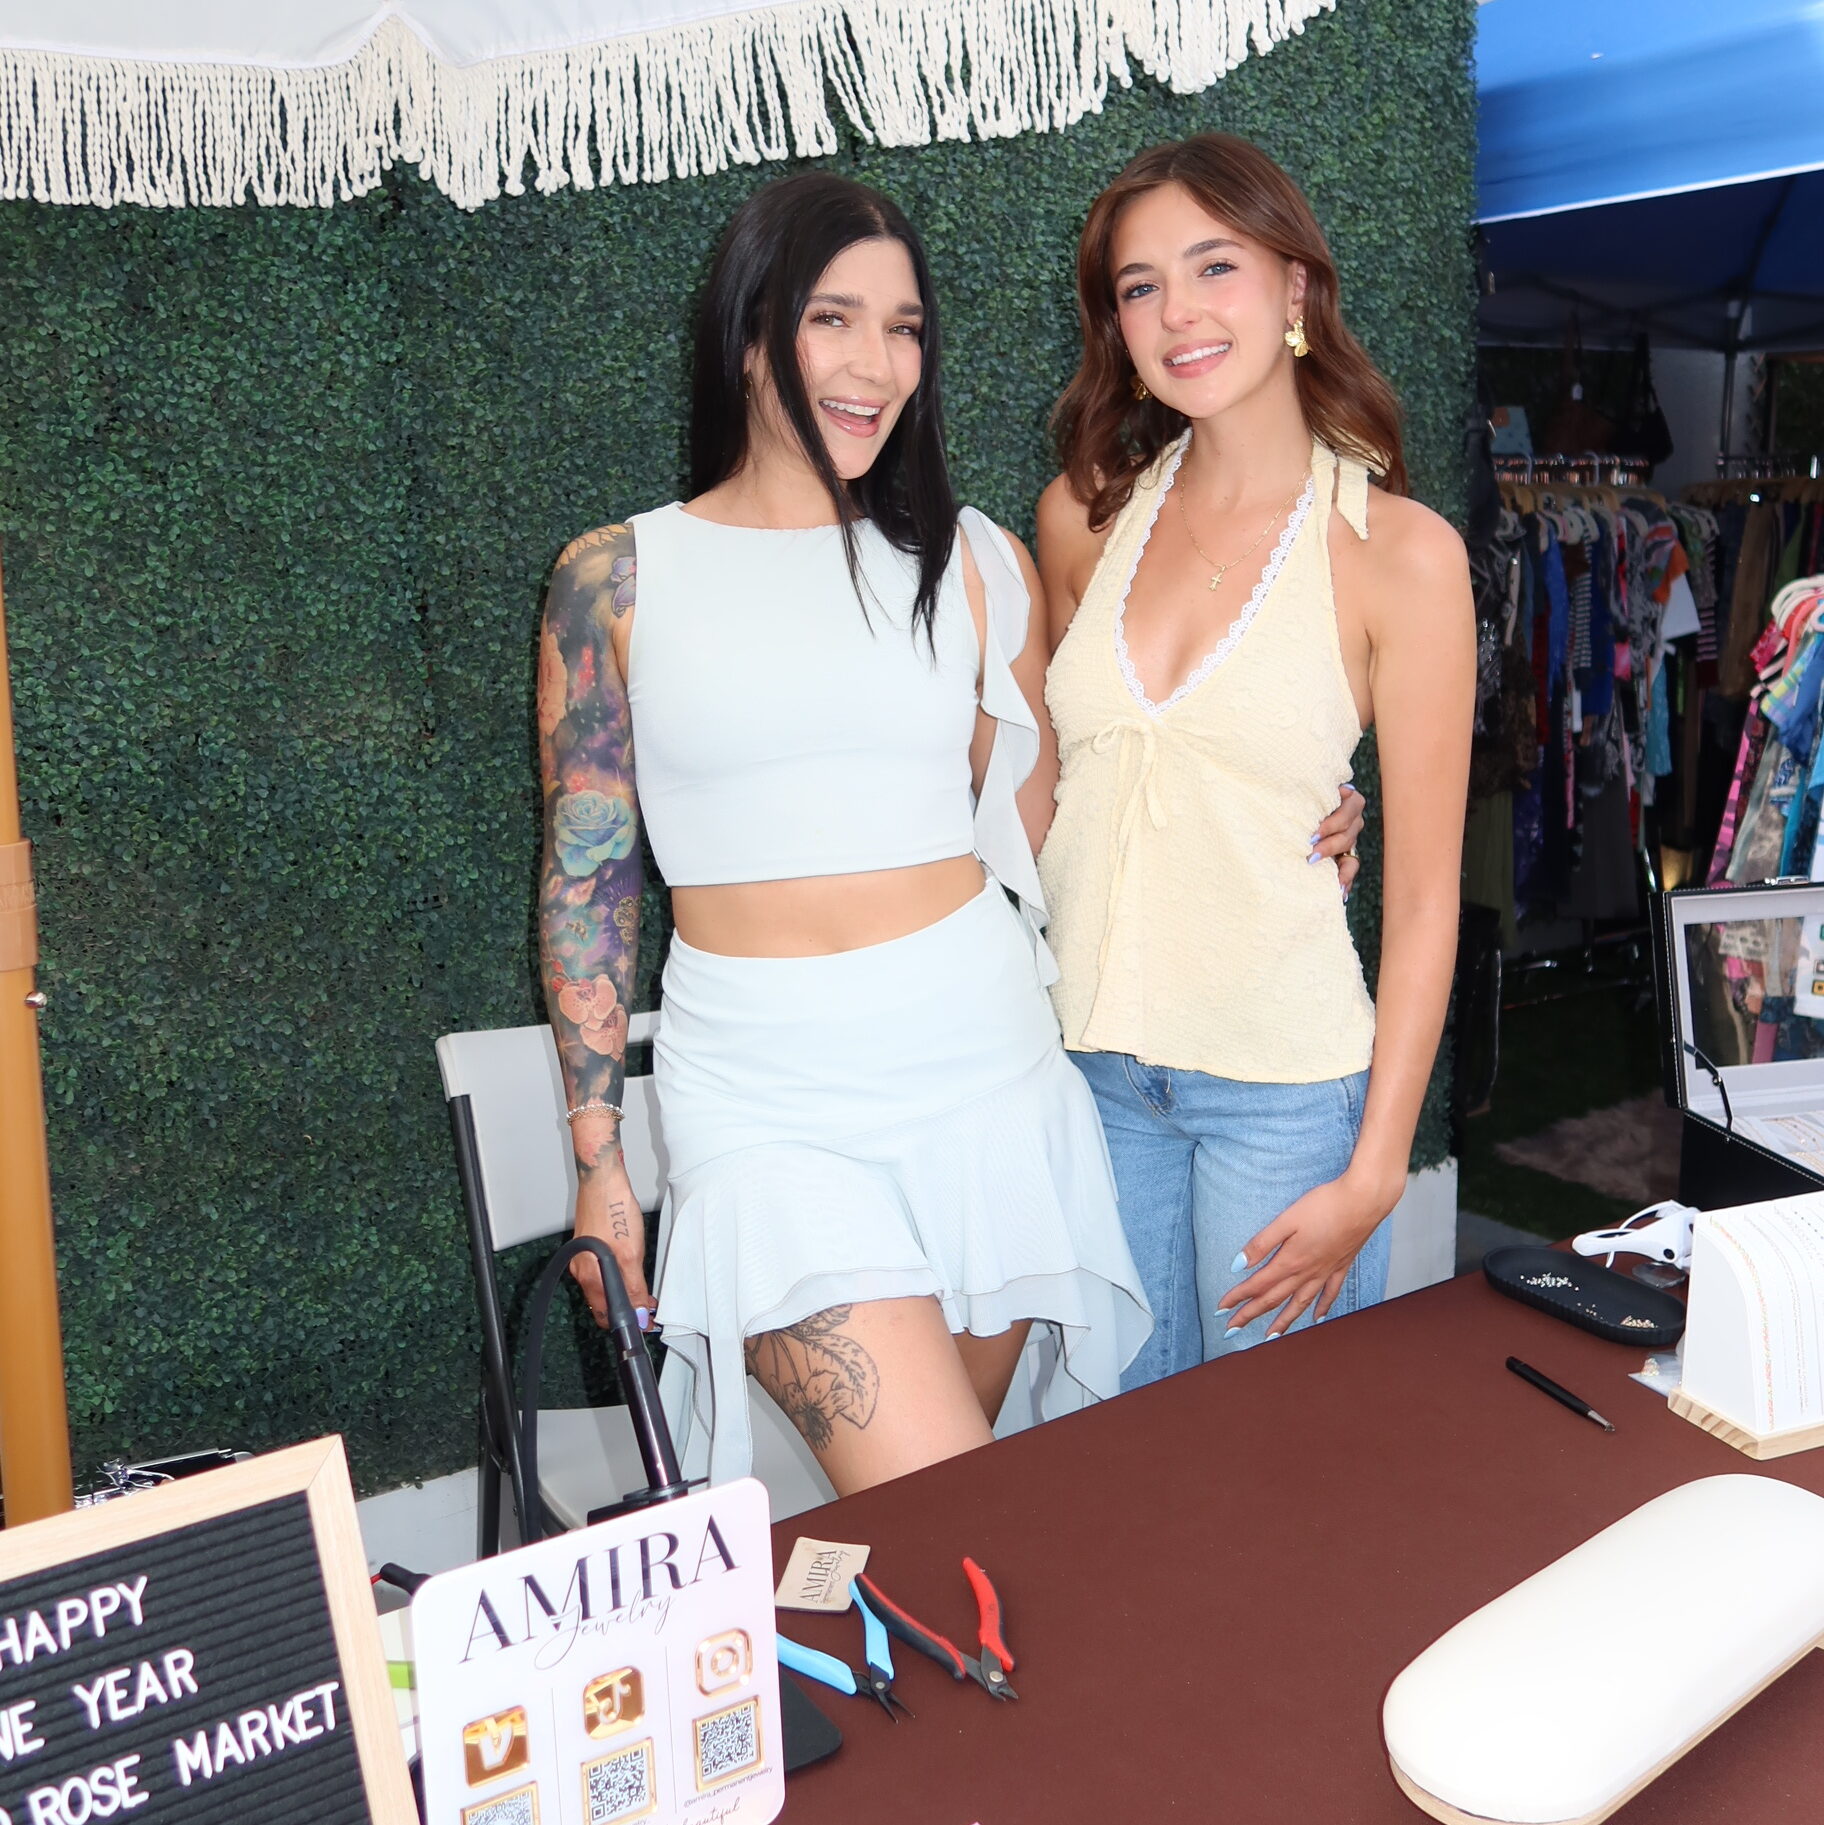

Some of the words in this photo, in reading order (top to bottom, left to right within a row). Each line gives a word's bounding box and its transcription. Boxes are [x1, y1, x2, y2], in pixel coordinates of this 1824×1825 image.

[608, 1200, 630, 1240] 2211
[457, 1513, 742, 1665] AMIRA
[798, 1550, 837, 1604] AMIRA
[0, 1575, 148, 1672] HAPPY
[72, 1648, 199, 1730] YEAR
[27, 1754, 150, 1825] ROSE
[174, 1681, 340, 1787] MARKET
[682, 1796, 741, 1825] autiful
